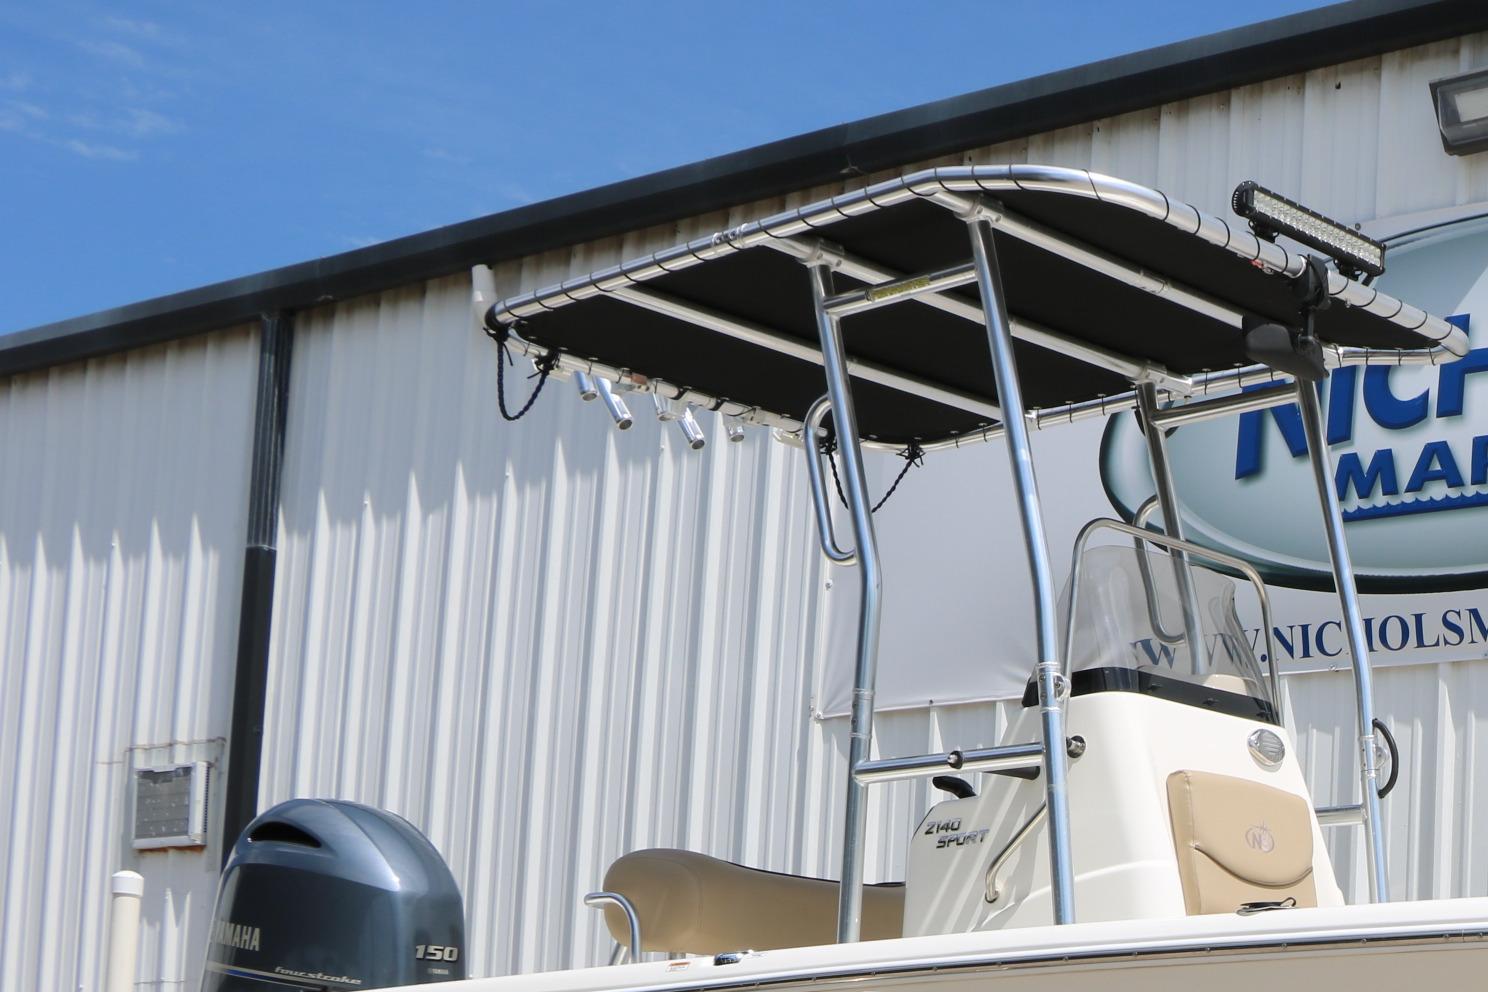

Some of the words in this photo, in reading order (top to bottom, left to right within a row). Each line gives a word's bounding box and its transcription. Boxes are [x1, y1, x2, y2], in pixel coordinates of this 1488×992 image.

[924, 817, 962, 835] 2140
[936, 827, 989, 849] SPORT
[415, 944, 459, 962] 150
